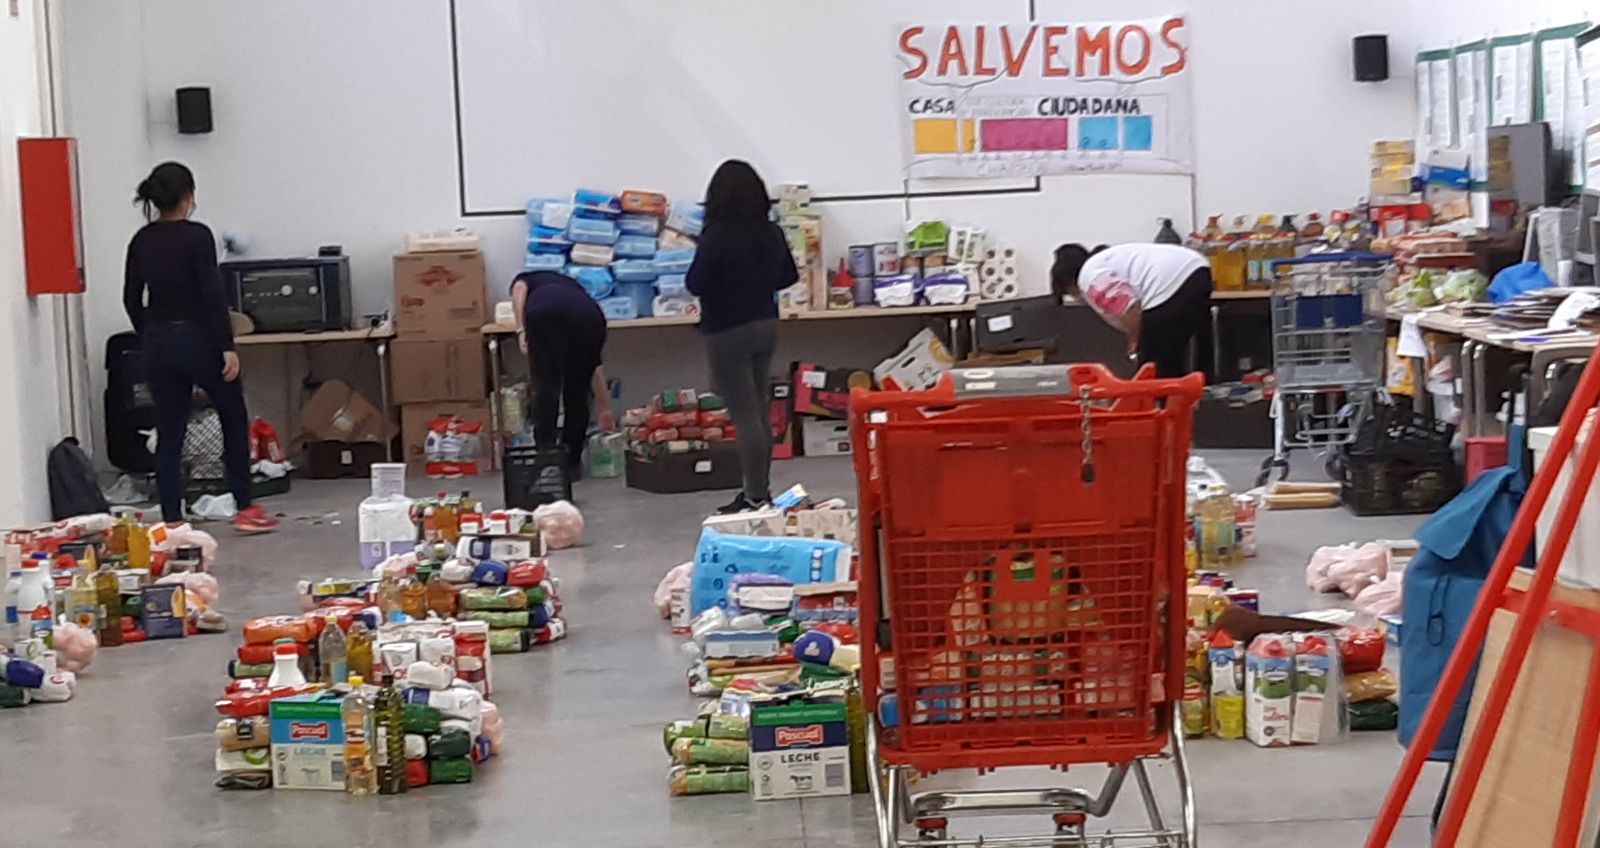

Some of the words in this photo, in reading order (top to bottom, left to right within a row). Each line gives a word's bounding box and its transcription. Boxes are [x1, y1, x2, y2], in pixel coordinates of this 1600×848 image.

[899, 18, 1186, 79] SALVEMOS
[908, 97, 955, 114] CASA
[1037, 97, 1140, 116] CIUDADANA
[778, 728, 819, 740] Pascual
[780, 752, 820, 763] LECHE
